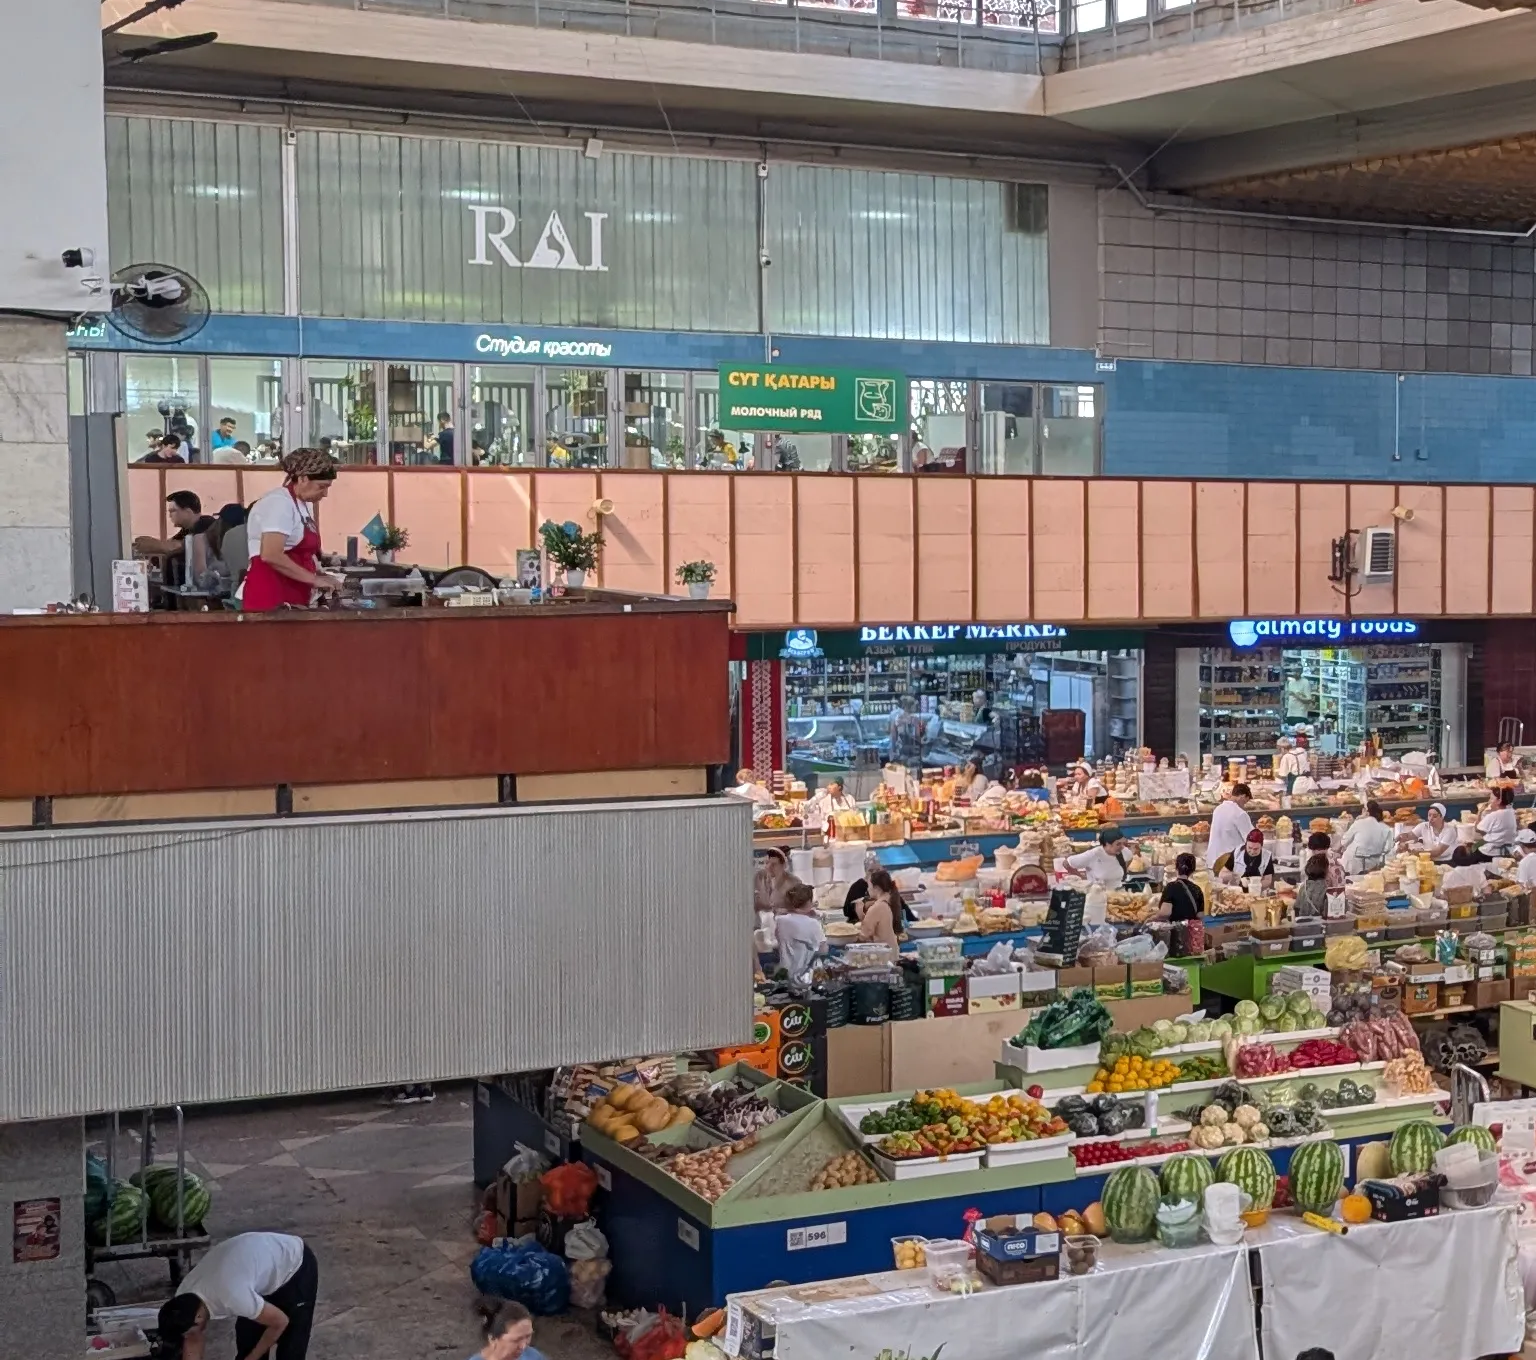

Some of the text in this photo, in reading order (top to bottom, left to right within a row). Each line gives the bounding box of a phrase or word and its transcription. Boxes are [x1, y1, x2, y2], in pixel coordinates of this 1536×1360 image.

[468, 205, 609, 271] RAI
[476, 334, 611, 357] Студия красоты
[765, 373, 835, 390] ҚАТАРЫ
[731, 405, 822, 420] МОЛОЧНЫЙ РЯД
[1256, 619, 1341, 638] almaty
[1005, 640, 1062, 651] ПРОДУКТЫ
